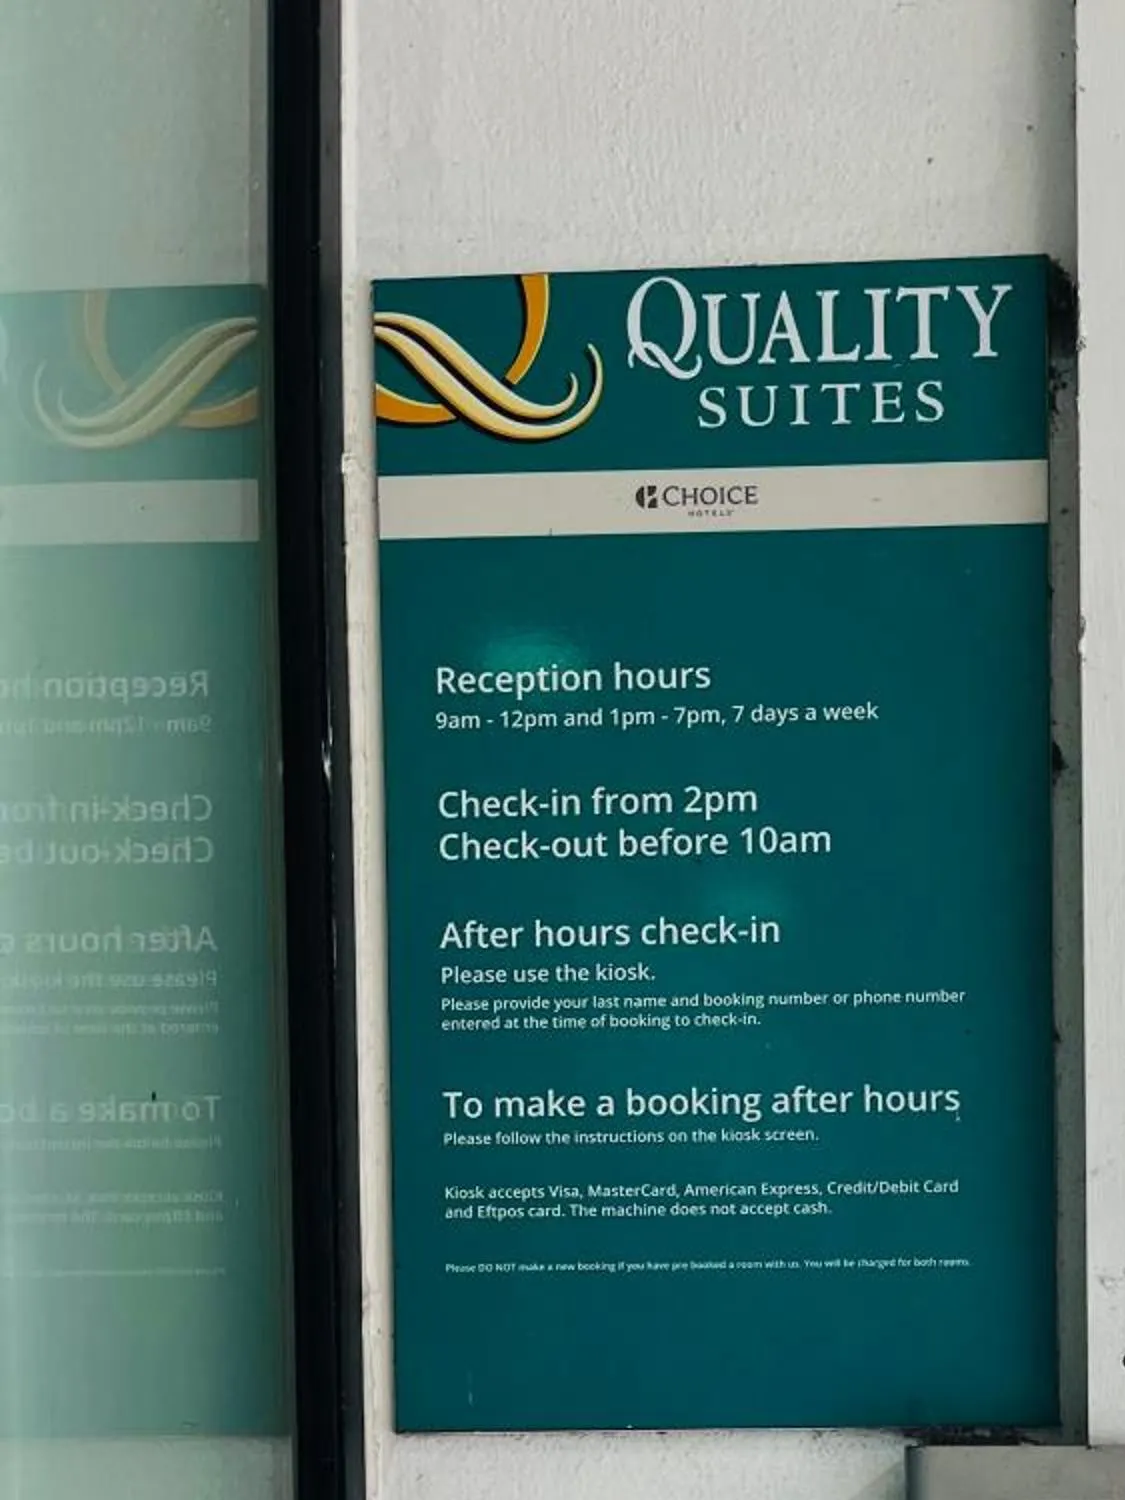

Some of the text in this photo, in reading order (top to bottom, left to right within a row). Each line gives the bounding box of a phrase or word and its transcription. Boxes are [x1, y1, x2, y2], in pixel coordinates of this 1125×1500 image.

[626, 275, 1013, 381] QUALITY
[697, 380, 945, 429] SUITES
[662, 485, 760, 507] CHOICE
[436, 661, 711, 700] Reception hours
[435, 711, 481, 731] 9am
[499, 709, 559, 733] 12pm
[562, 707, 604, 728] and
[609, 707, 656, 731] 1pm
[673, 705, 727, 729] 7pm,
[730, 704, 745, 724] 7
[750, 703, 800, 727] days
[804, 706, 817, 721] a
[822, 700, 880, 721] week
[438, 785, 758, 821] Check-in from 2pm
[439, 825, 832, 861] Check-out before 10am
[439, 915, 781, 950] After hours check-in
[441, 961, 656, 985] Please use the kiosk.
[441, 988, 967, 1014] Please provide your last name and booking number or phone number
[441, 1011, 762, 1031] entered at the time of booking to check-in.
[441, 1083, 961, 1123] To make a booking after hours
[443, 1127, 820, 1146] Please follow the instructions on the kiosk screen.
[444, 1178, 960, 1202] Kiosk accepts Visa, MasterCard, American Express, Credit/Debit Card
[444, 1200, 833, 1222] and Eftpos card. The machine does not accept cash.
